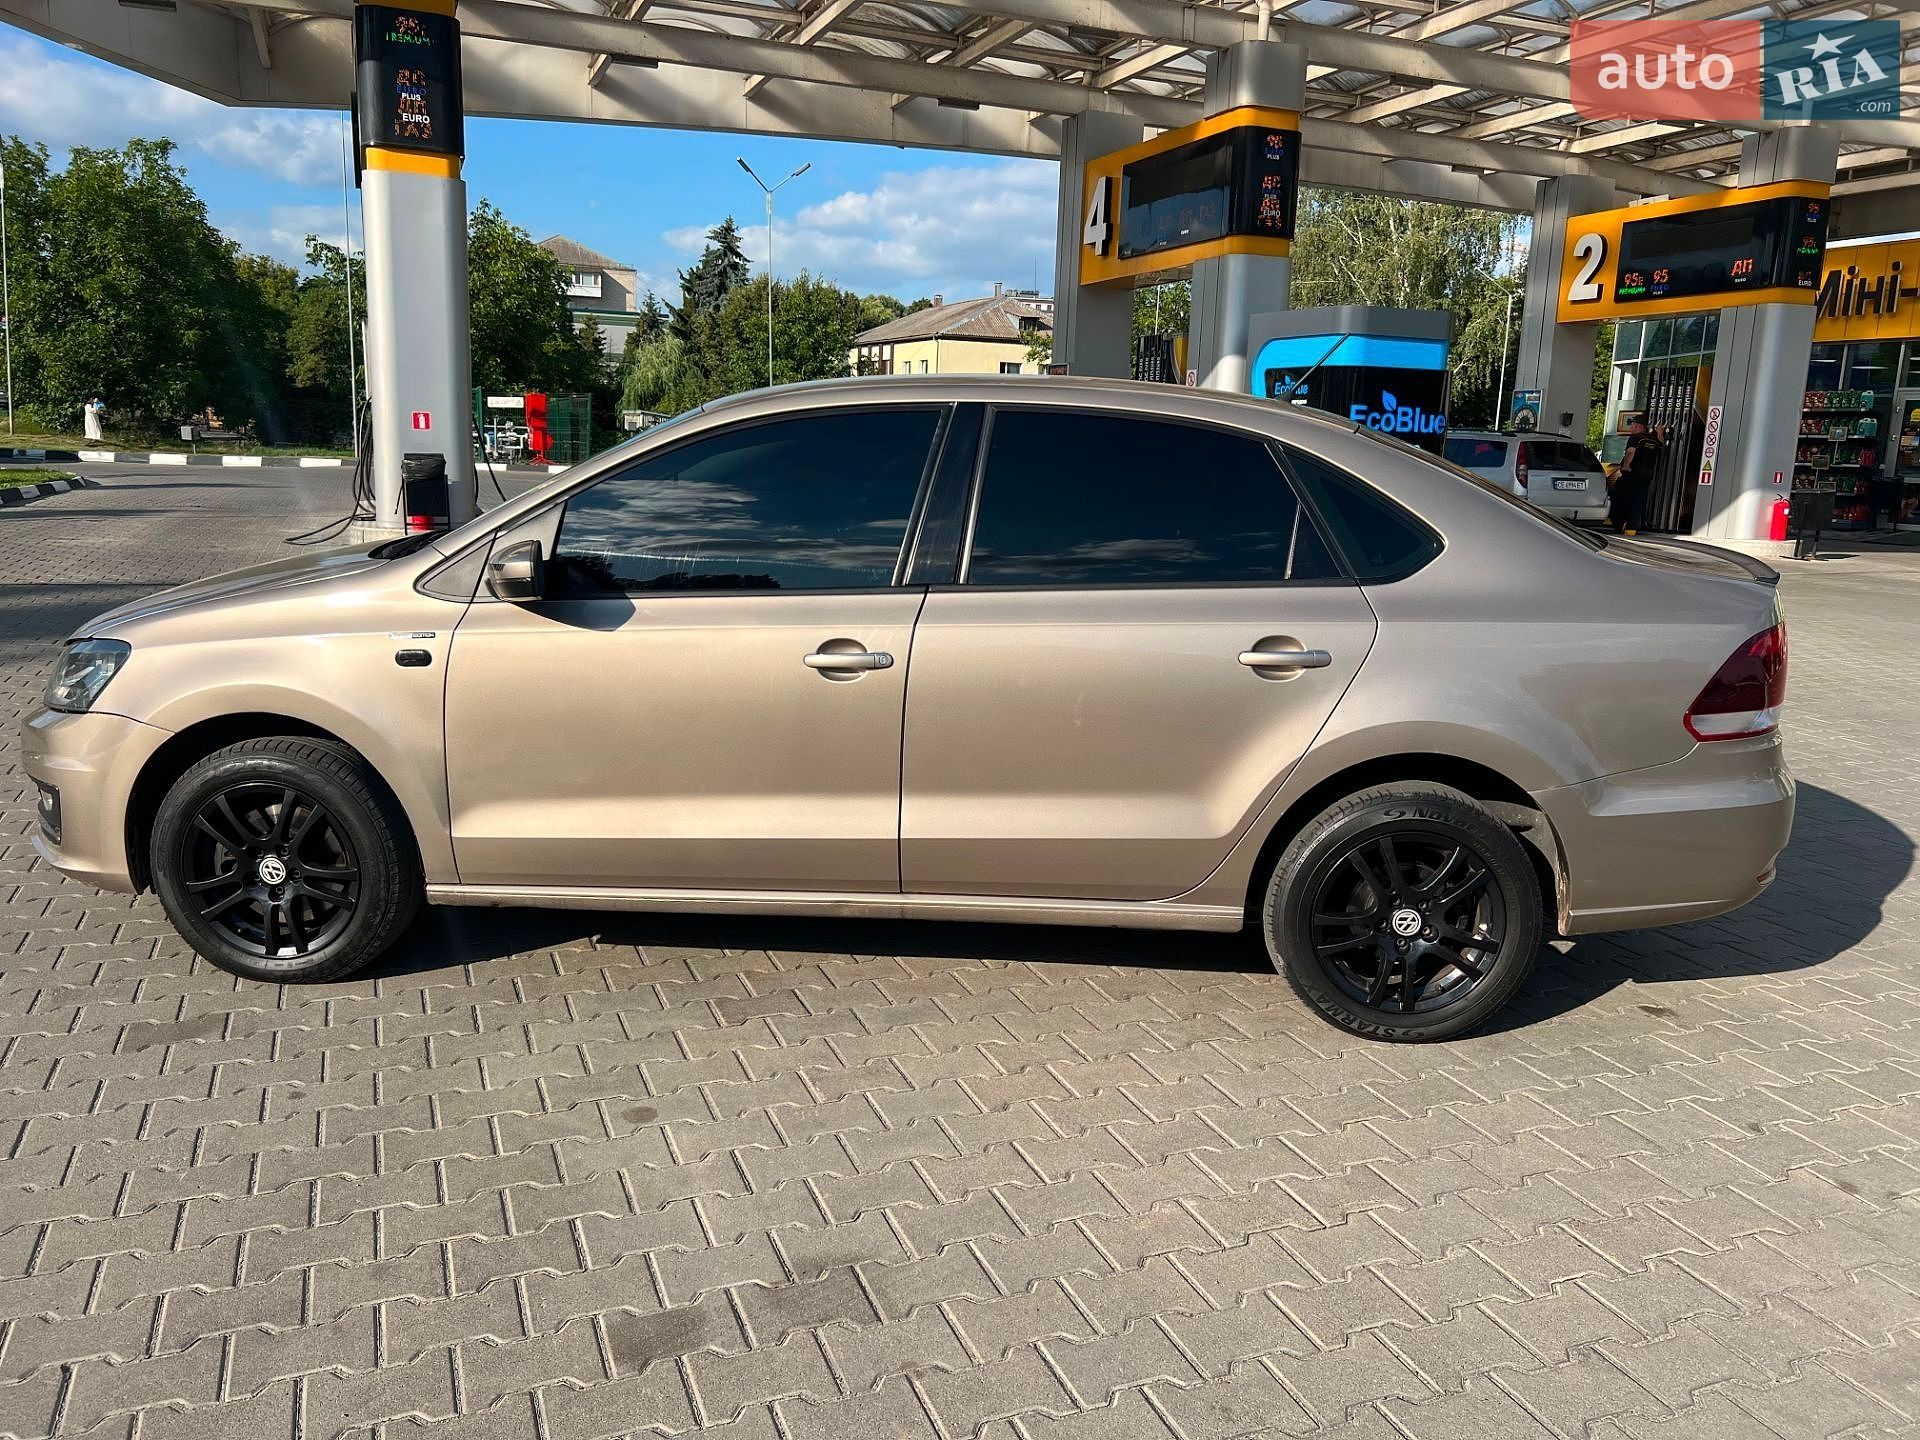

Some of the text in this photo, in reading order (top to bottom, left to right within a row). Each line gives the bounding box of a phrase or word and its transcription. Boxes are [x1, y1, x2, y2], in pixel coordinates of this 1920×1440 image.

[401, 92, 421, 101] PLUS
[402, 113, 430, 124] EURO
[1084, 176, 1109, 256] 4
[1567, 232, 1605, 301] 2
[1652, 268, 1669, 284] 95
[1275, 380, 1309, 396] Ecoue
[1350, 403, 1446, 434] EcoBlue
